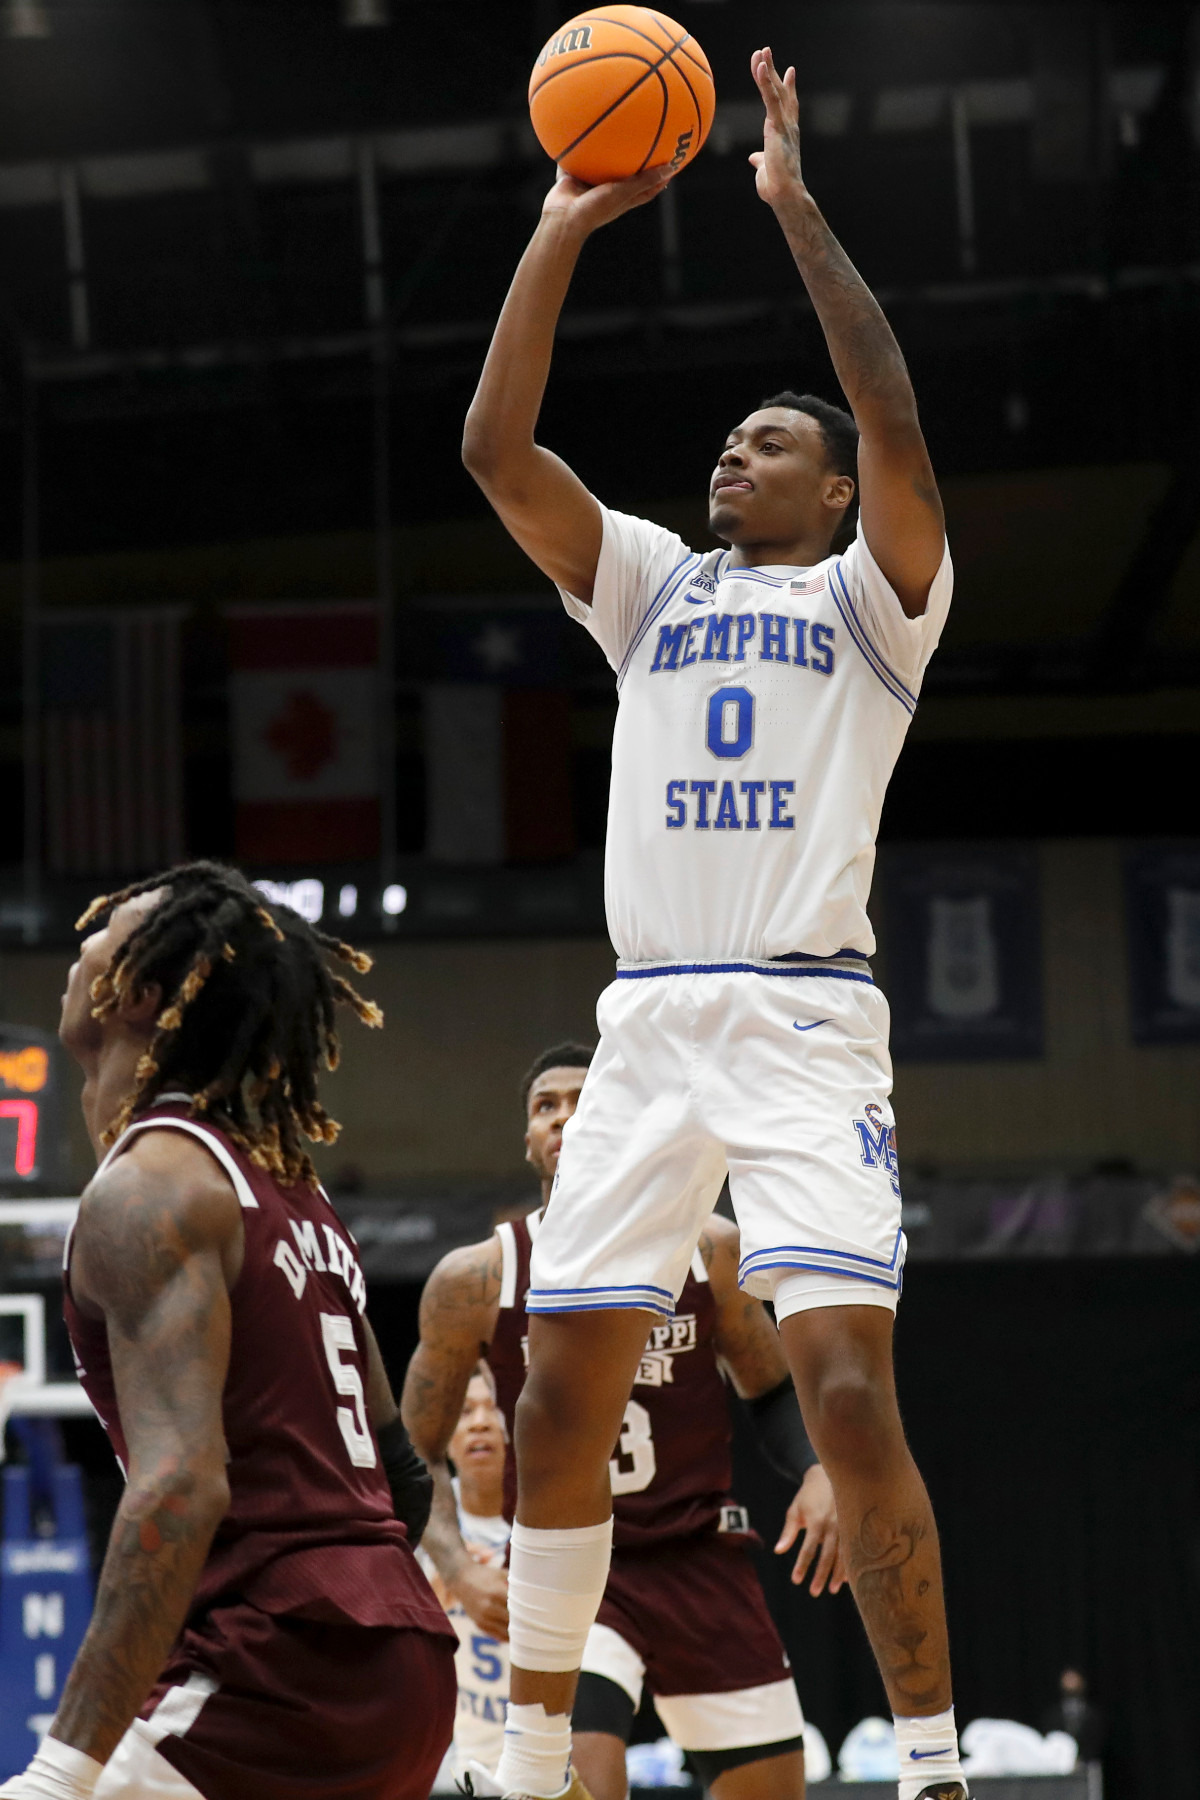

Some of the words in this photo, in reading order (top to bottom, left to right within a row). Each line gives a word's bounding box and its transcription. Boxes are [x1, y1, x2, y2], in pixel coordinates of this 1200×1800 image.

[650, 613, 835, 677] MEMPHIS
[705, 685, 756, 761] 0
[666, 780, 795, 831] STATE
[319, 1312, 377, 1469] 5
[470, 1634, 502, 1682] 5
